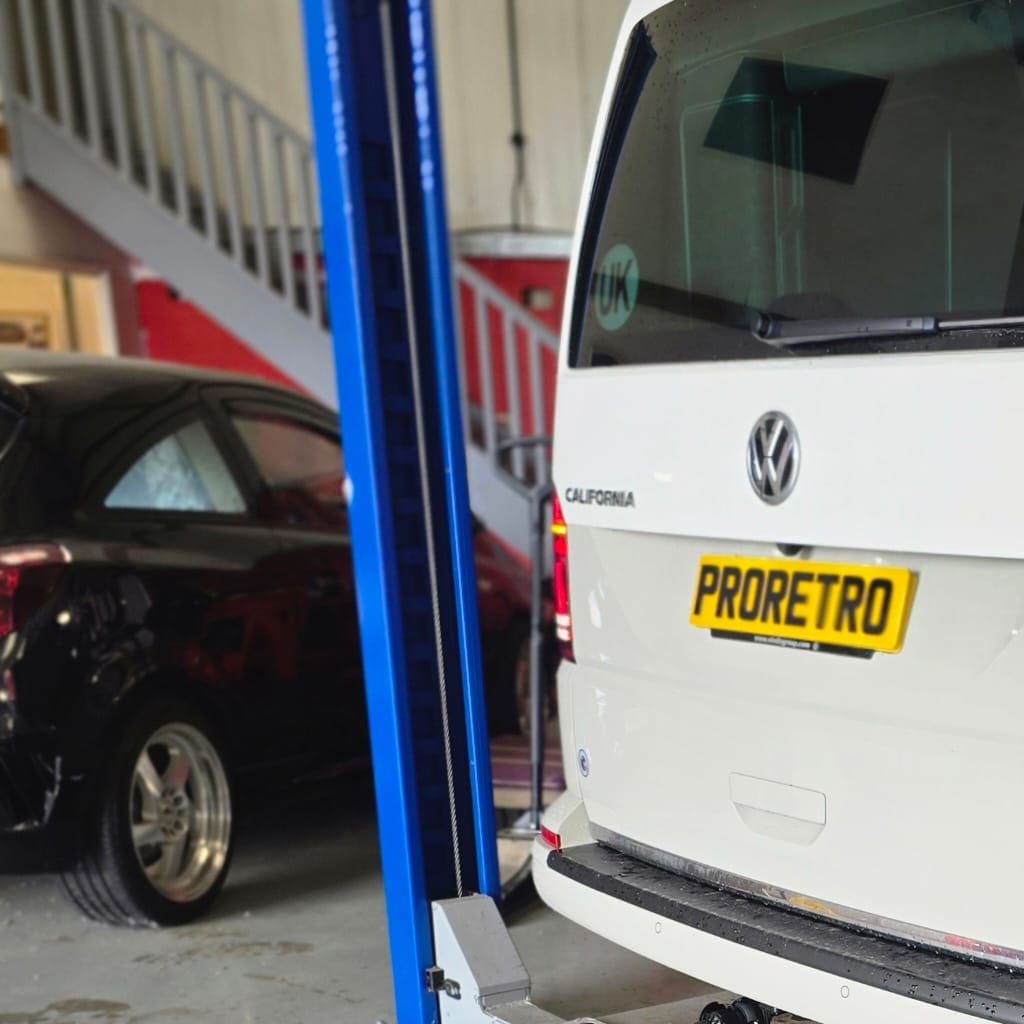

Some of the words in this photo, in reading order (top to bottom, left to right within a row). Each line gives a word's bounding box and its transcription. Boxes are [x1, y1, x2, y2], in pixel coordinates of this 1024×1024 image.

[598, 258, 633, 317] UK
[565, 487, 636, 508] CALIFORNIA
[693, 563, 894, 636] PRORETRO
